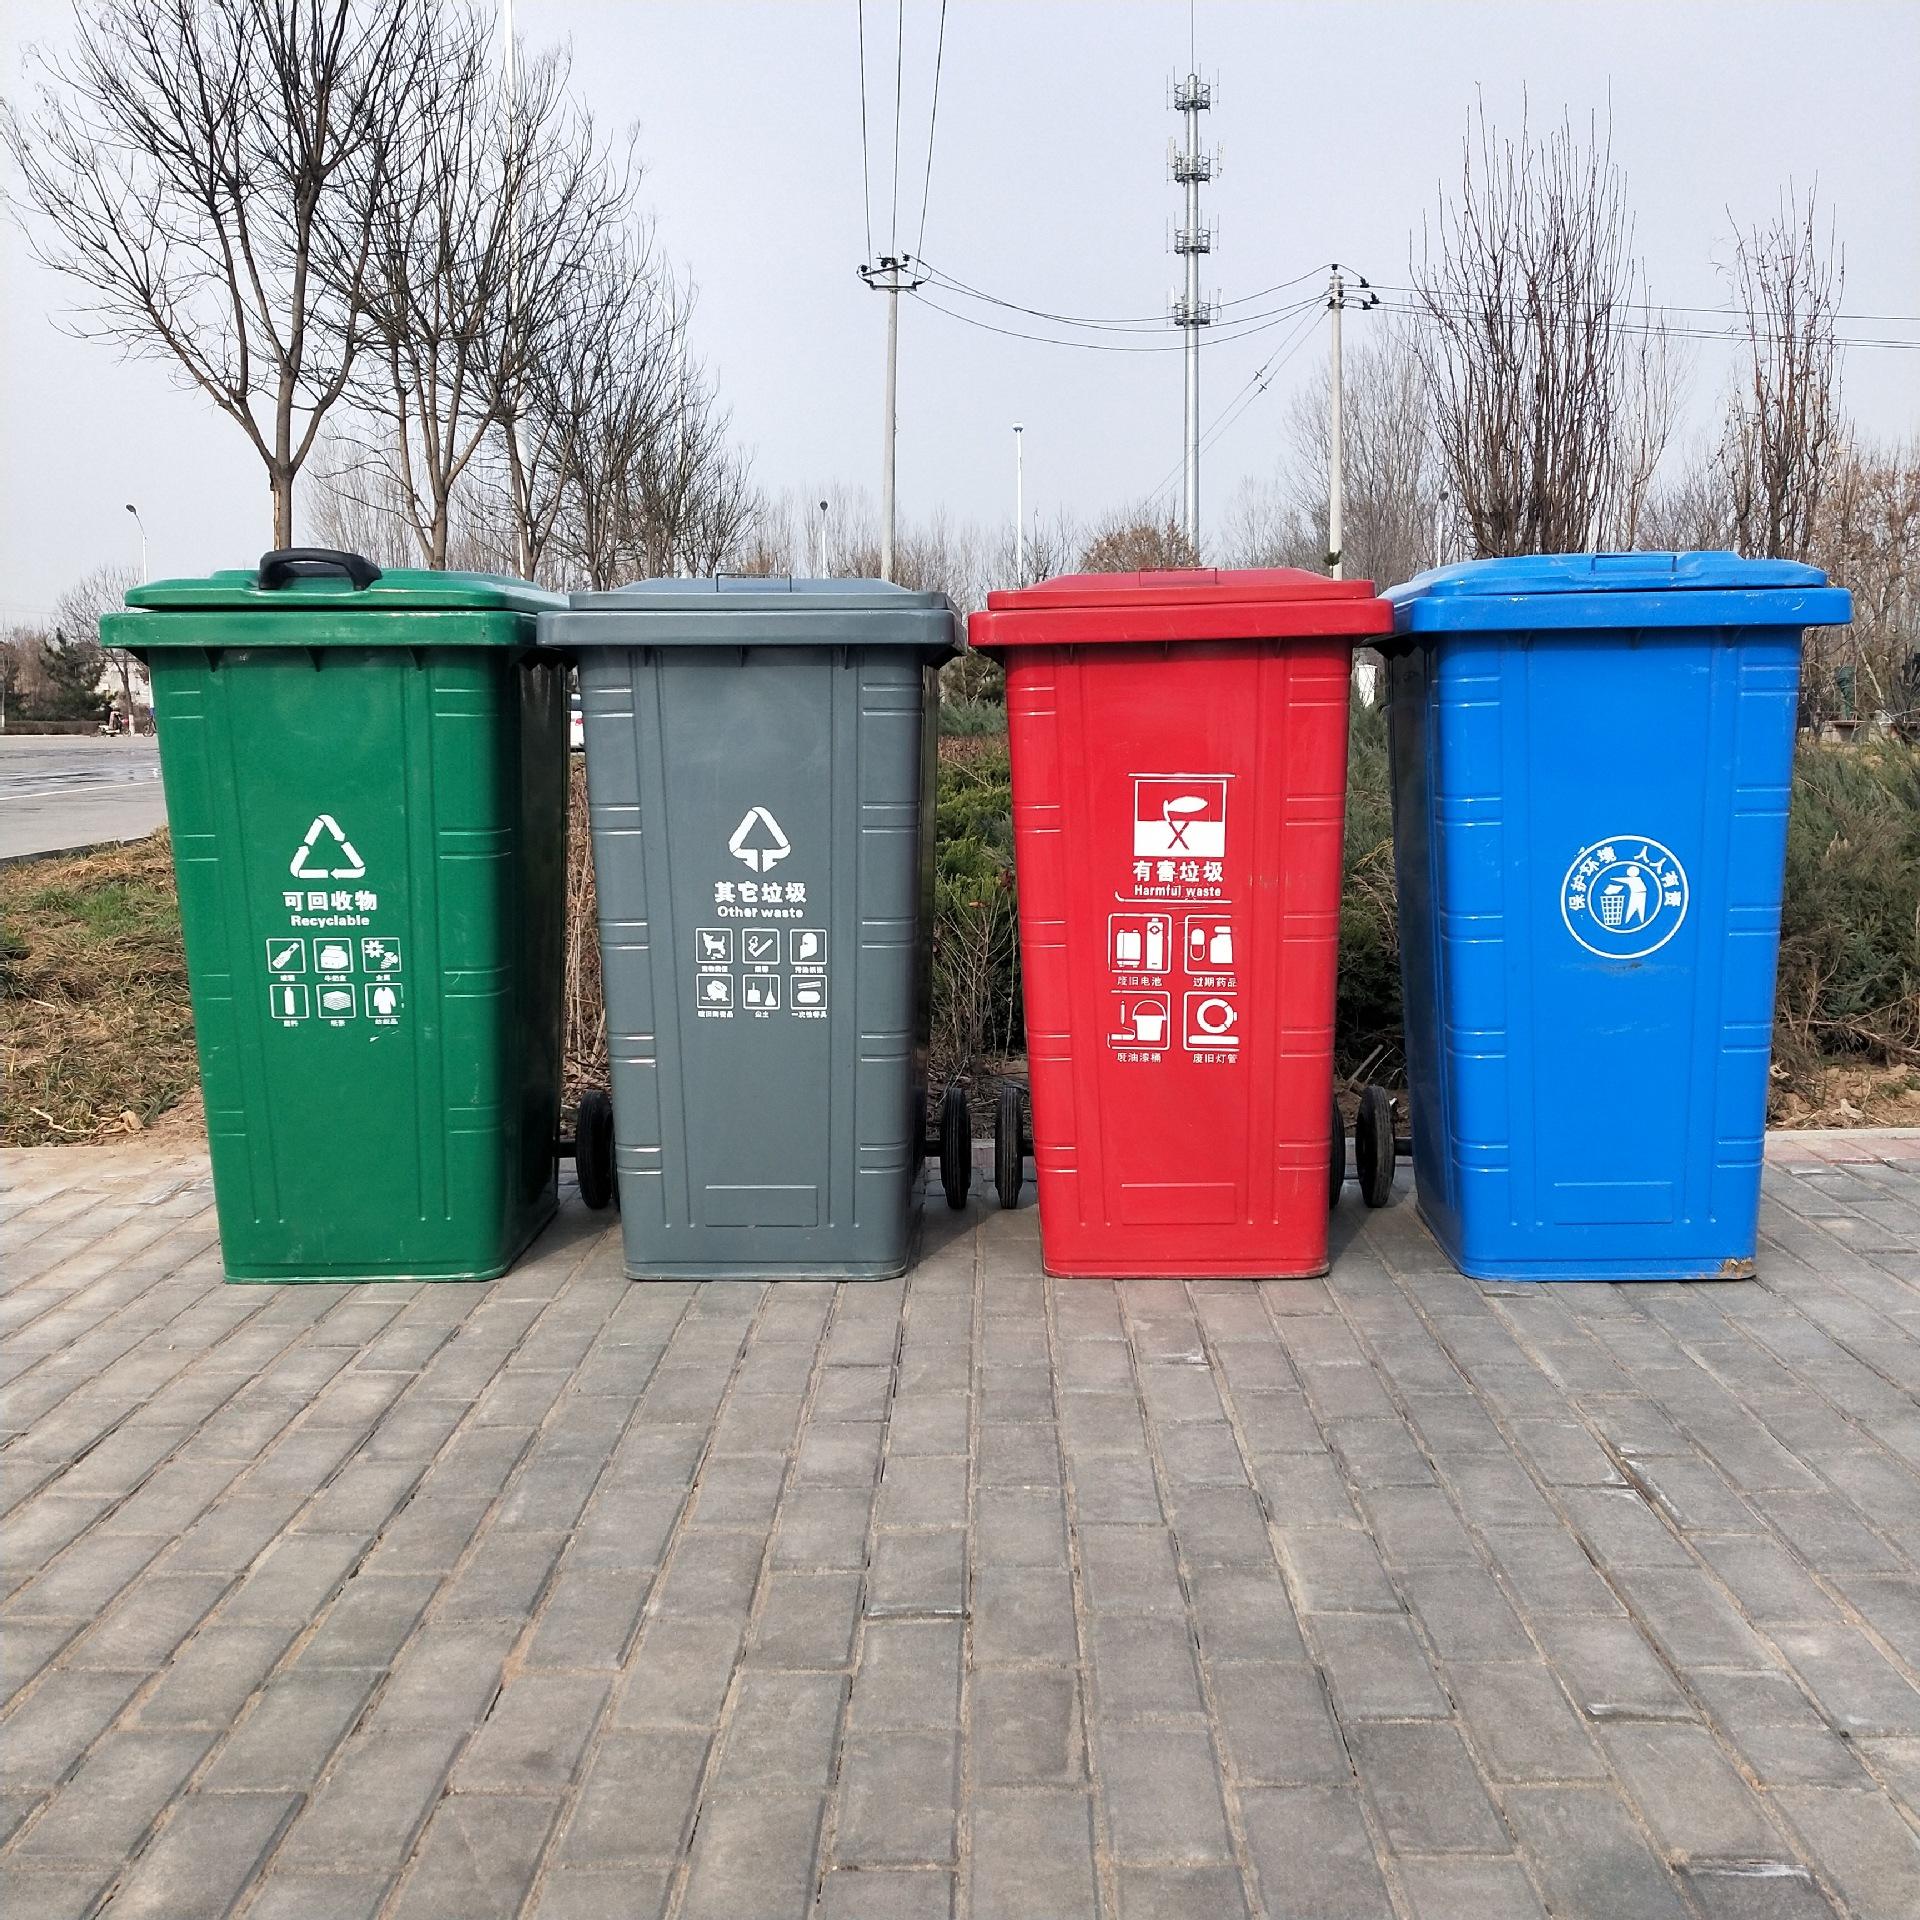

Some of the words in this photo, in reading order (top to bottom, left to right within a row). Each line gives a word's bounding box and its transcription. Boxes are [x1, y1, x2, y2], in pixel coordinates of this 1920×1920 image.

[1132, 860, 1224, 882] 有害垃圾
[1568, 845, 1617, 911] 保护环境
[1633, 845, 1682, 907] 人人有责
[714, 880, 807, 903] 其它垃圾
[1134, 884, 1182, 897] Harmful
[1185, 886, 1222, 898] waste
[282, 890, 378, 911] 可回收物
[717, 905, 758, 918] Other
[760, 907, 804, 918] waste
[290, 914, 370, 928] Recyclable
[1193, 977, 1238, 988] 过期药品
[1192, 1053, 1238, 1064] 废旧灯管
